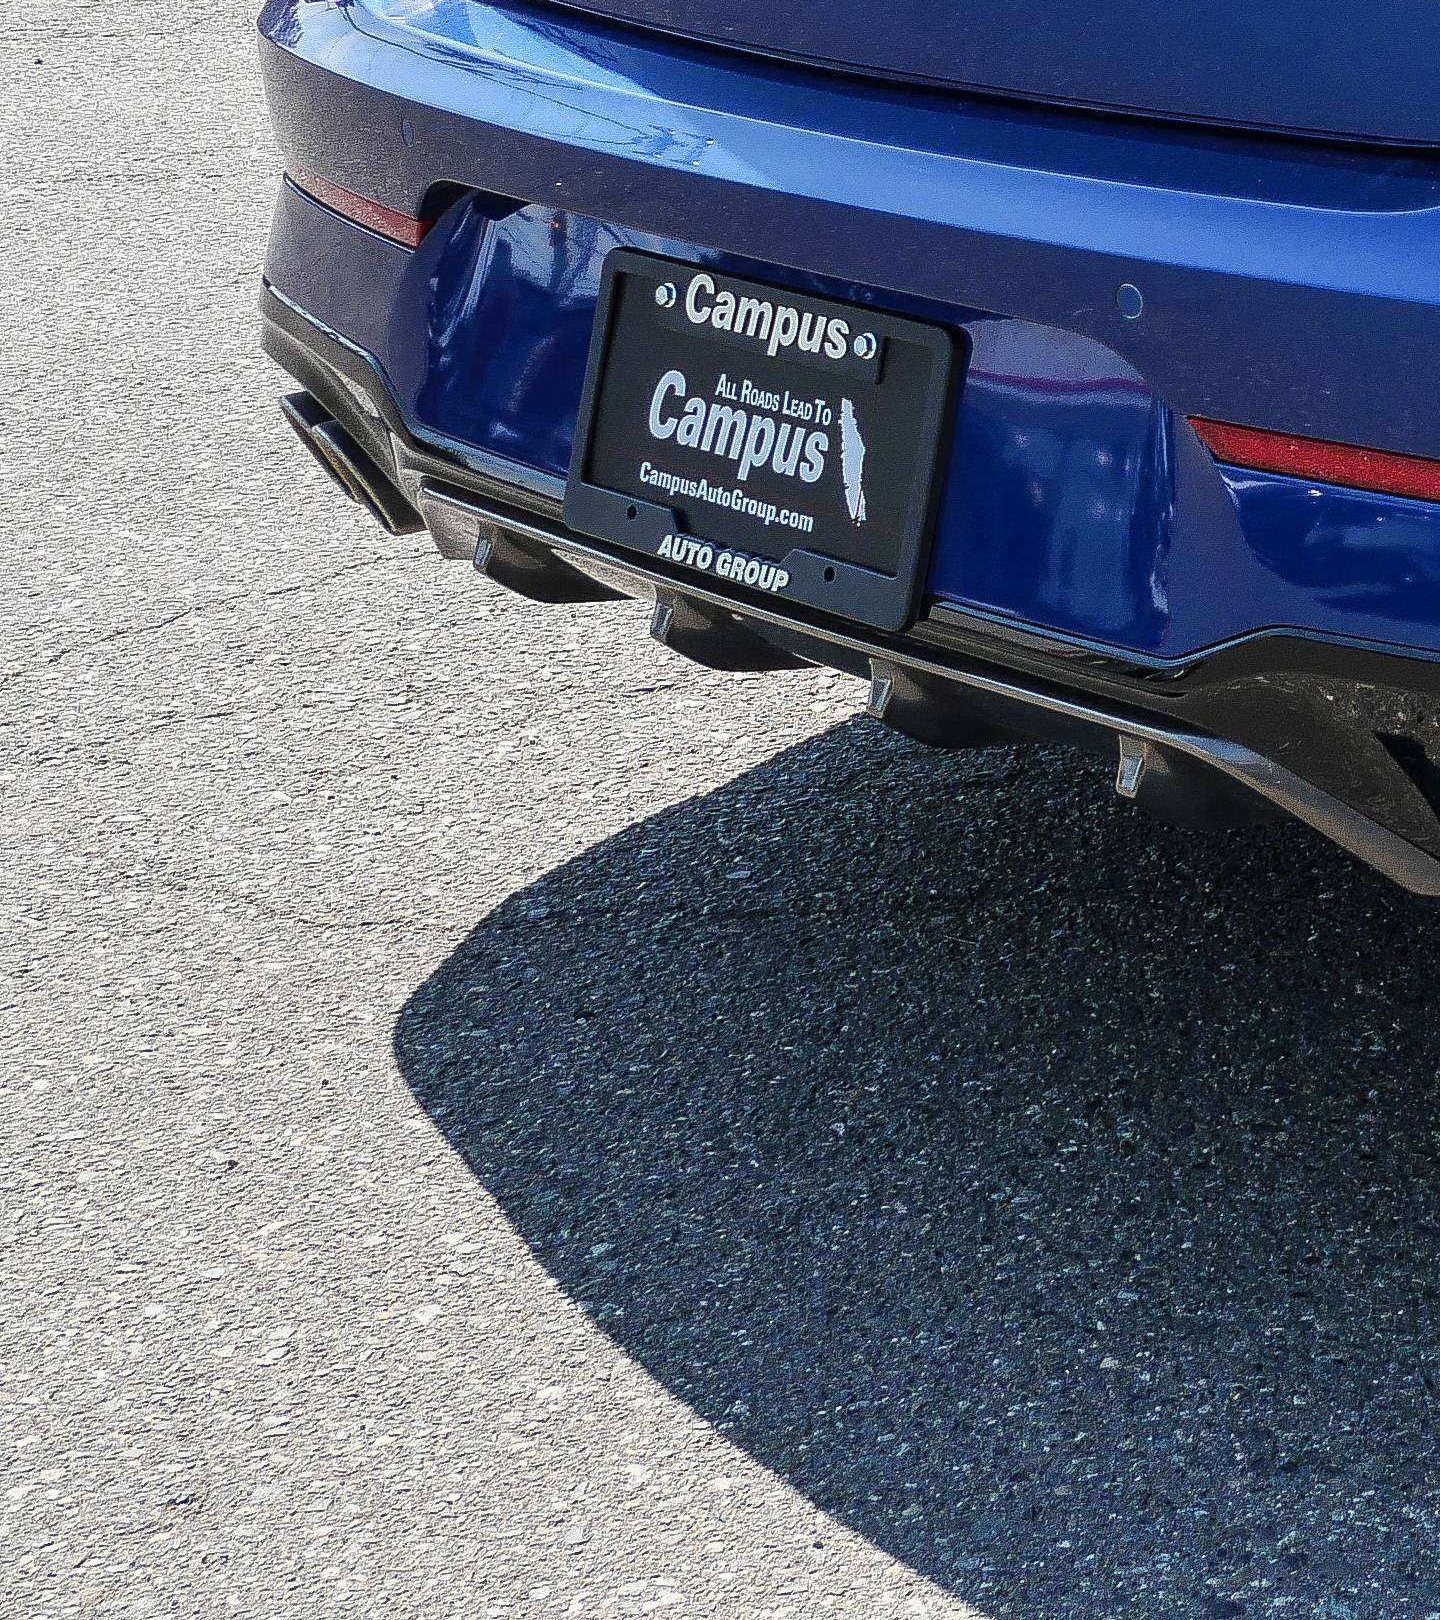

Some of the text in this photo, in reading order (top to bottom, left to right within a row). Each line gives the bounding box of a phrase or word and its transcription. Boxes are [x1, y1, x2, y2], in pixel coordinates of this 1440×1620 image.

[685, 273, 851, 360] Campus
[648, 369, 829, 483] Campus
[639, 461, 814, 533] CampusAutoGroup.com
[656, 534, 790, 592] AUTO GROUP
